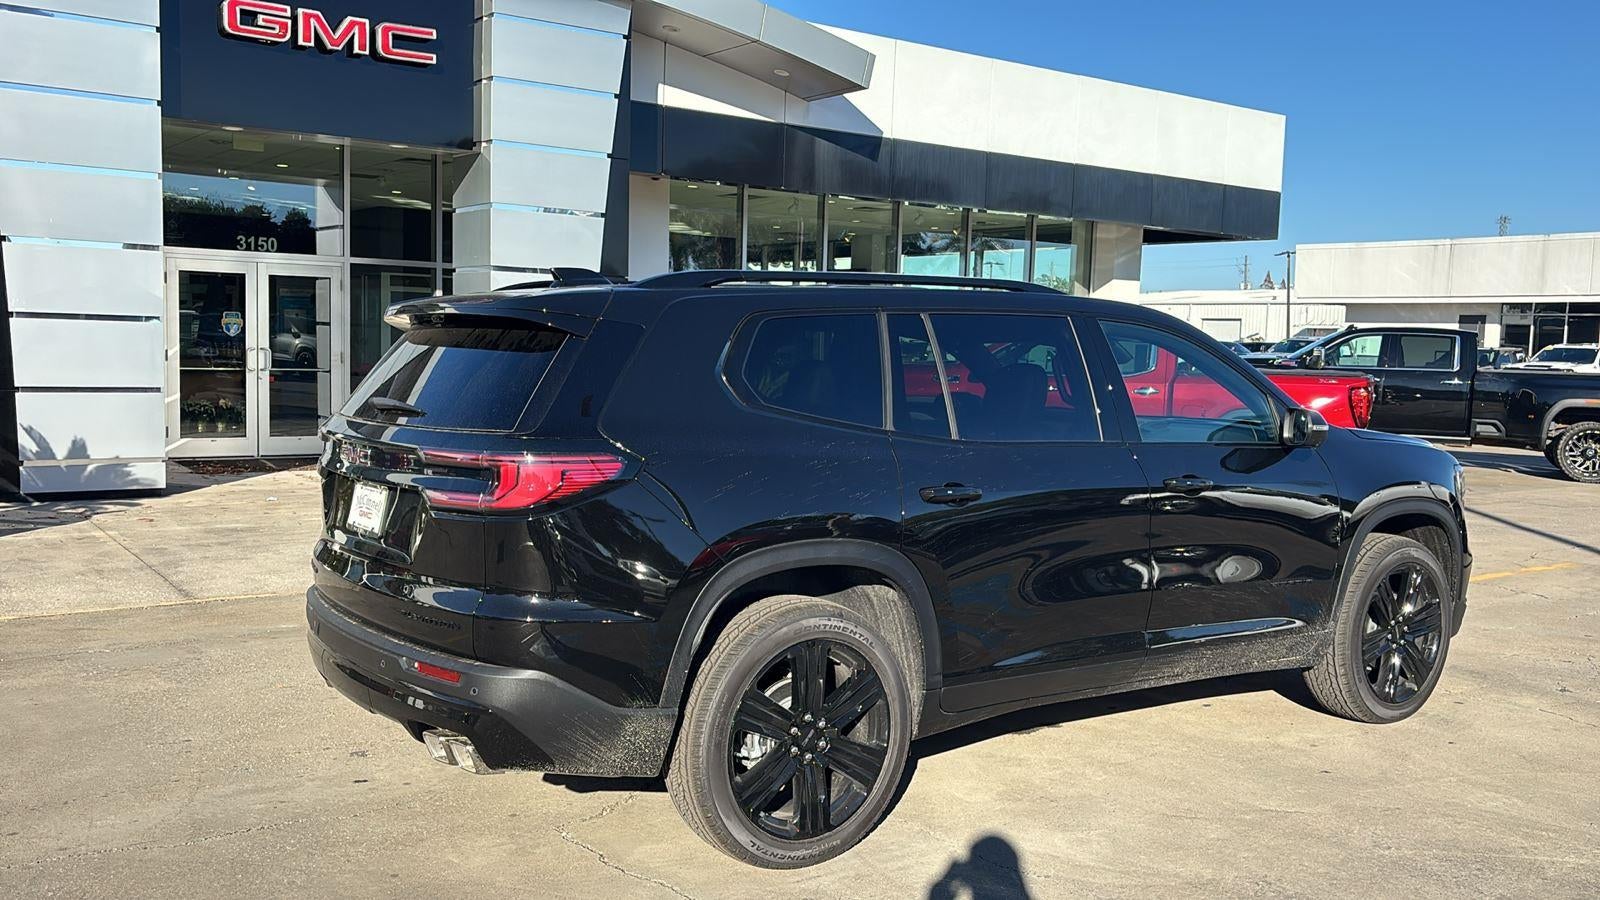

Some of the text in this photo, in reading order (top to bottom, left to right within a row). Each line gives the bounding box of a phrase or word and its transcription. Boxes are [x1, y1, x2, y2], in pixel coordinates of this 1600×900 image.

[220, 0, 437, 64] GMC
[236, 235, 278, 252] 3150
[793, 623, 876, 650] CONTINENTAL
